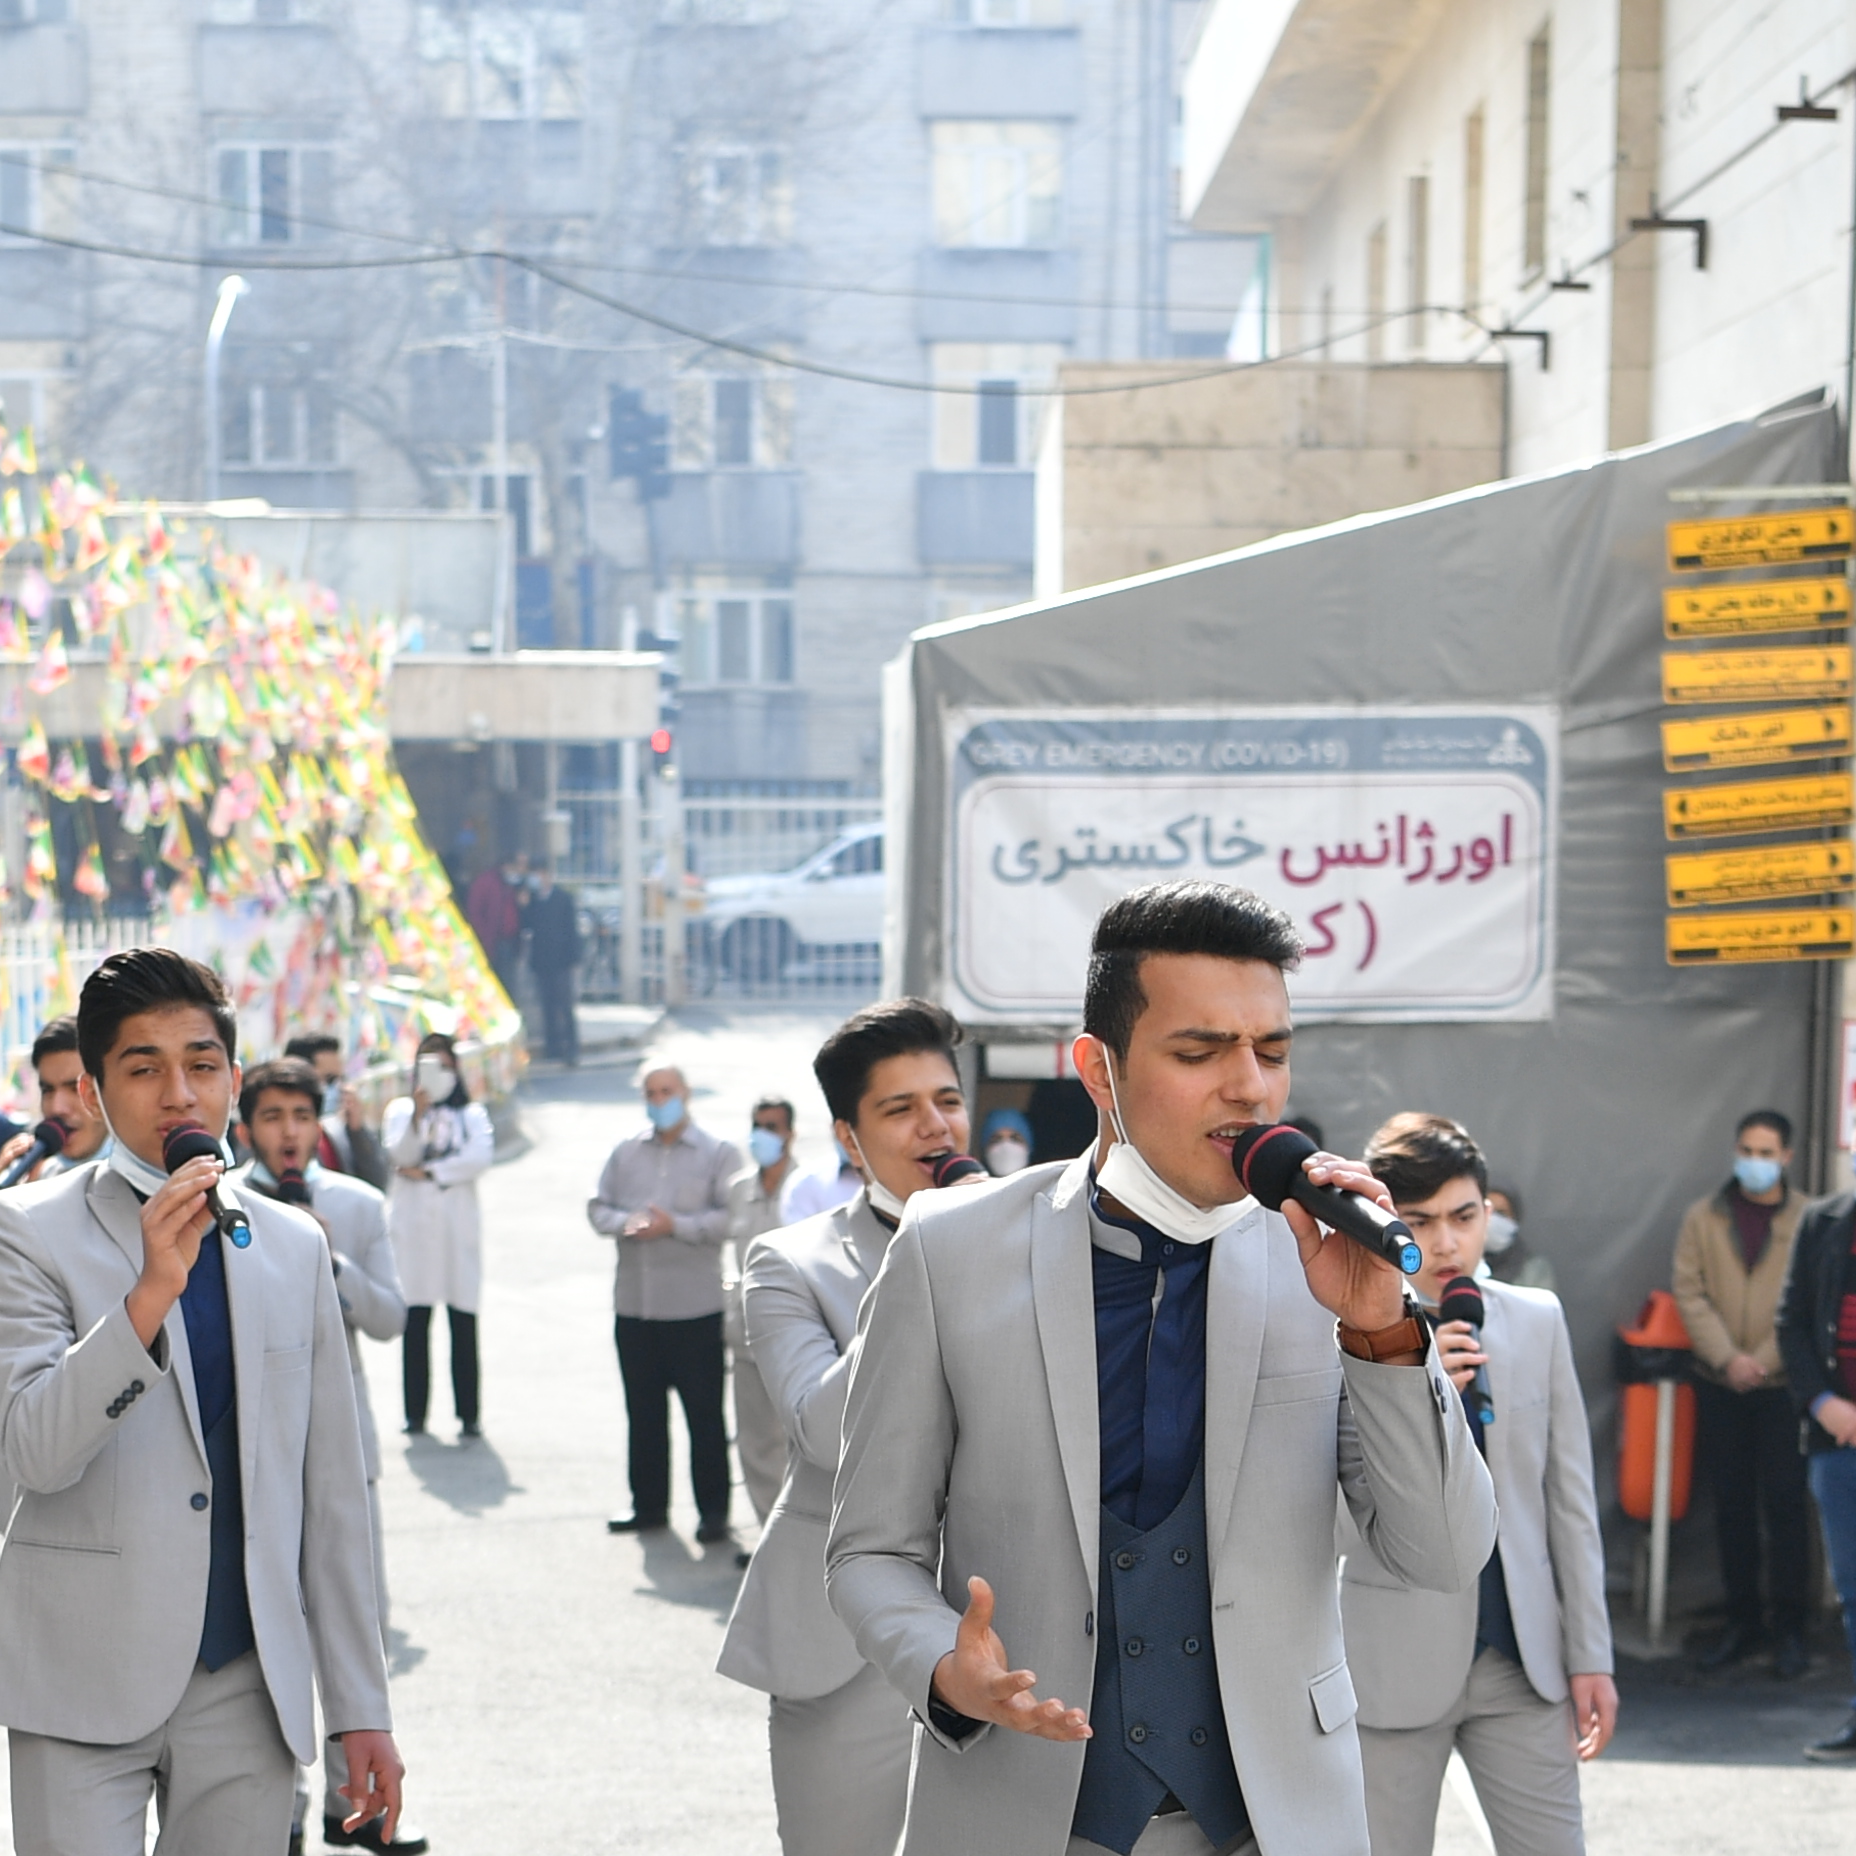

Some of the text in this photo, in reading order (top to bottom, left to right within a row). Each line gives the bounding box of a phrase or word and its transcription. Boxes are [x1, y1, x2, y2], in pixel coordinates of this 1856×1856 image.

[973, 739, 1349, 771] GREY EMERGENCY (COVID-19)
[991, 813, 1514, 886] اورژانس خاکستری
